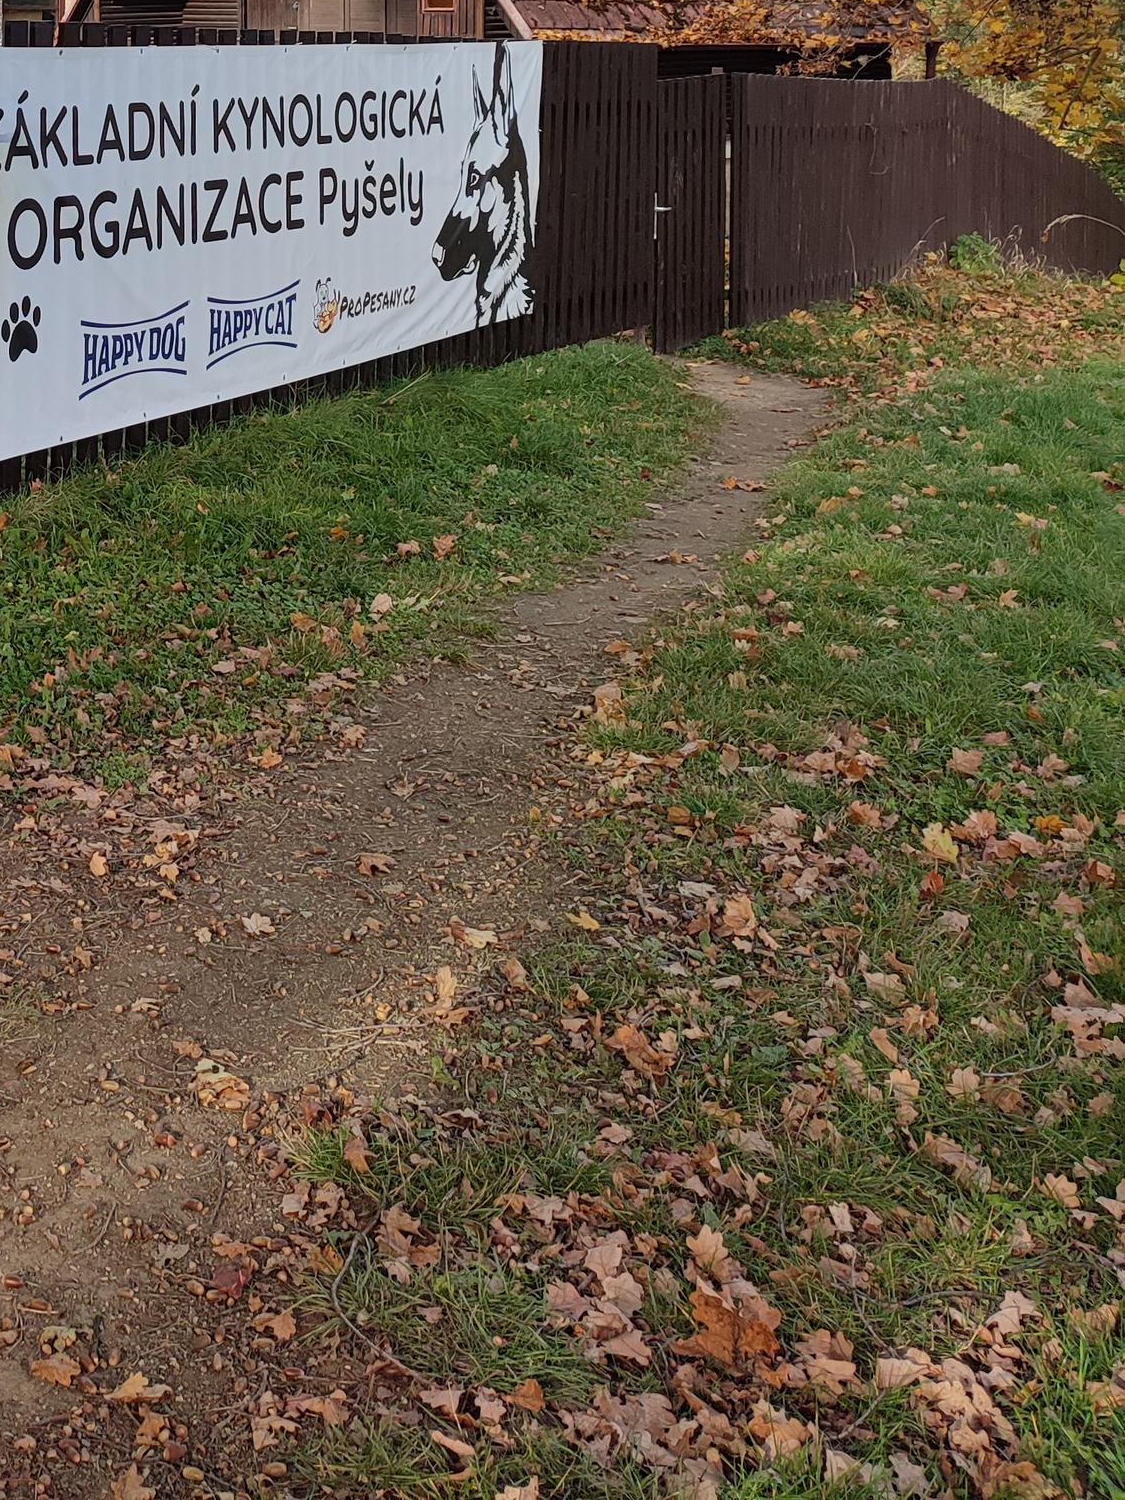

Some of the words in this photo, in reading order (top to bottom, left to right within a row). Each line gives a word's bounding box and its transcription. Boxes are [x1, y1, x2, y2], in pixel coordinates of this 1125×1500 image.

[212, 74, 445, 154] KYNOLOGICKÁ
[7, 170, 305, 270] ORGANIZACE
[319, 158, 424, 238] Pyšely
[208, 306, 263, 357] HAPPY
[264, 292, 297, 336] CAT
[339, 285, 417, 320] PROPESANY.CZ
[82, 325, 145, 386] HAPPY
[149, 315, 186, 363] DOG
